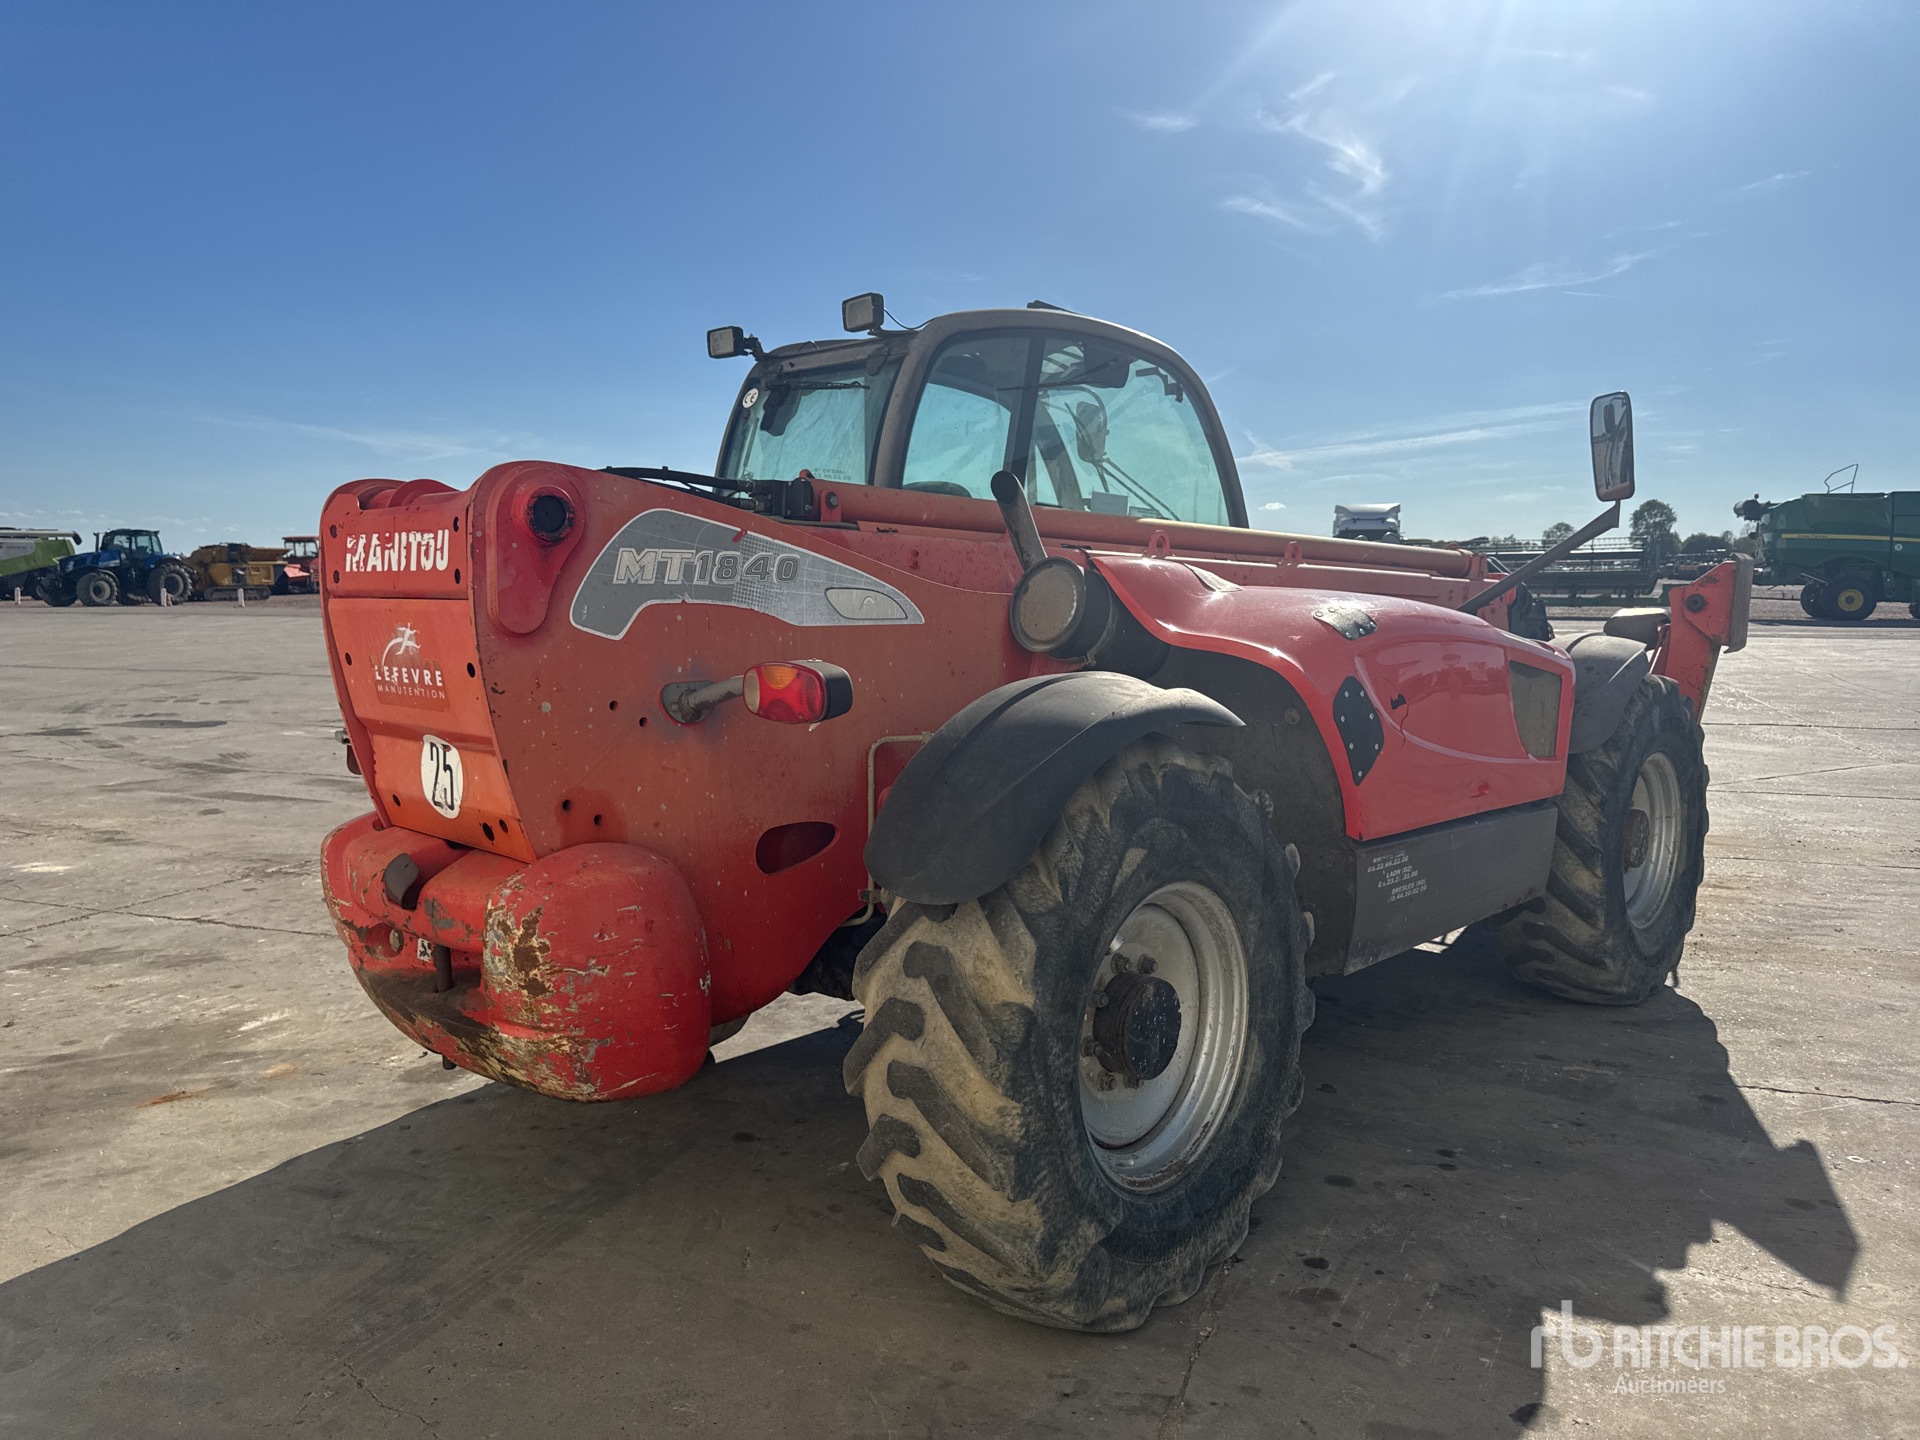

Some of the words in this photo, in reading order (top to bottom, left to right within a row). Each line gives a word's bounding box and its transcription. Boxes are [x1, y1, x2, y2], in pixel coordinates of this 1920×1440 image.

[345, 529, 449, 572] MANITOU
[613, 548, 800, 585] MT1840
[374, 664, 443, 687] LEFEVRE
[377, 684, 446, 700] MANUTENTION
[430, 741, 455, 811] 25
